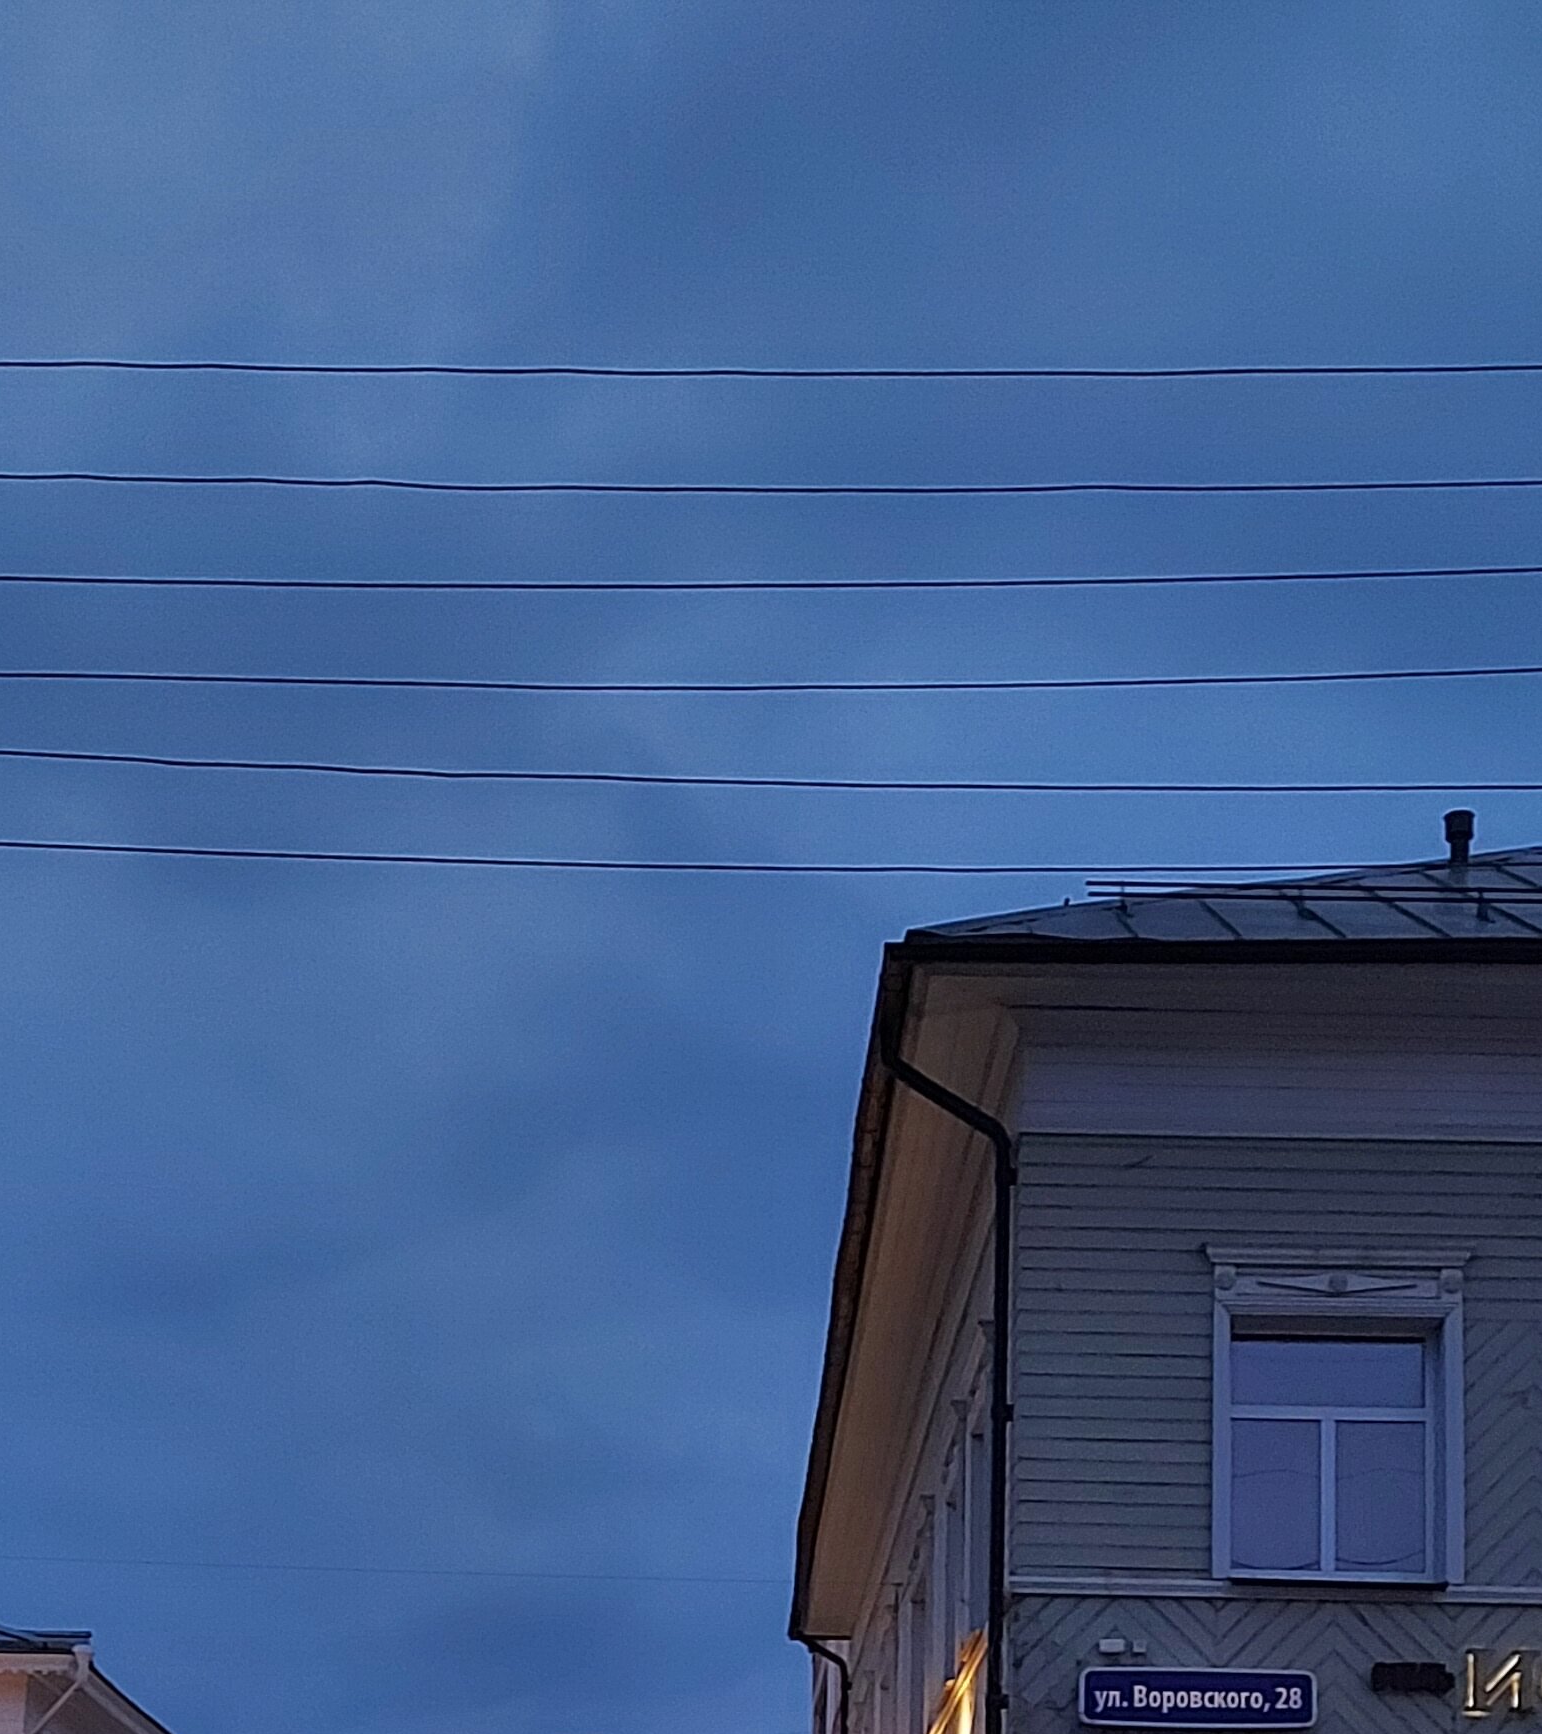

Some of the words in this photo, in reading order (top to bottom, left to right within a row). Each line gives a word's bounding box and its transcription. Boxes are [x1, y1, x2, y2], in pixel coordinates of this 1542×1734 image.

[1093, 1690, 1129, 1713] ул.
[1133, 1685, 1271, 1713] Воровского,
[1274, 1687, 1303, 1709] 28
